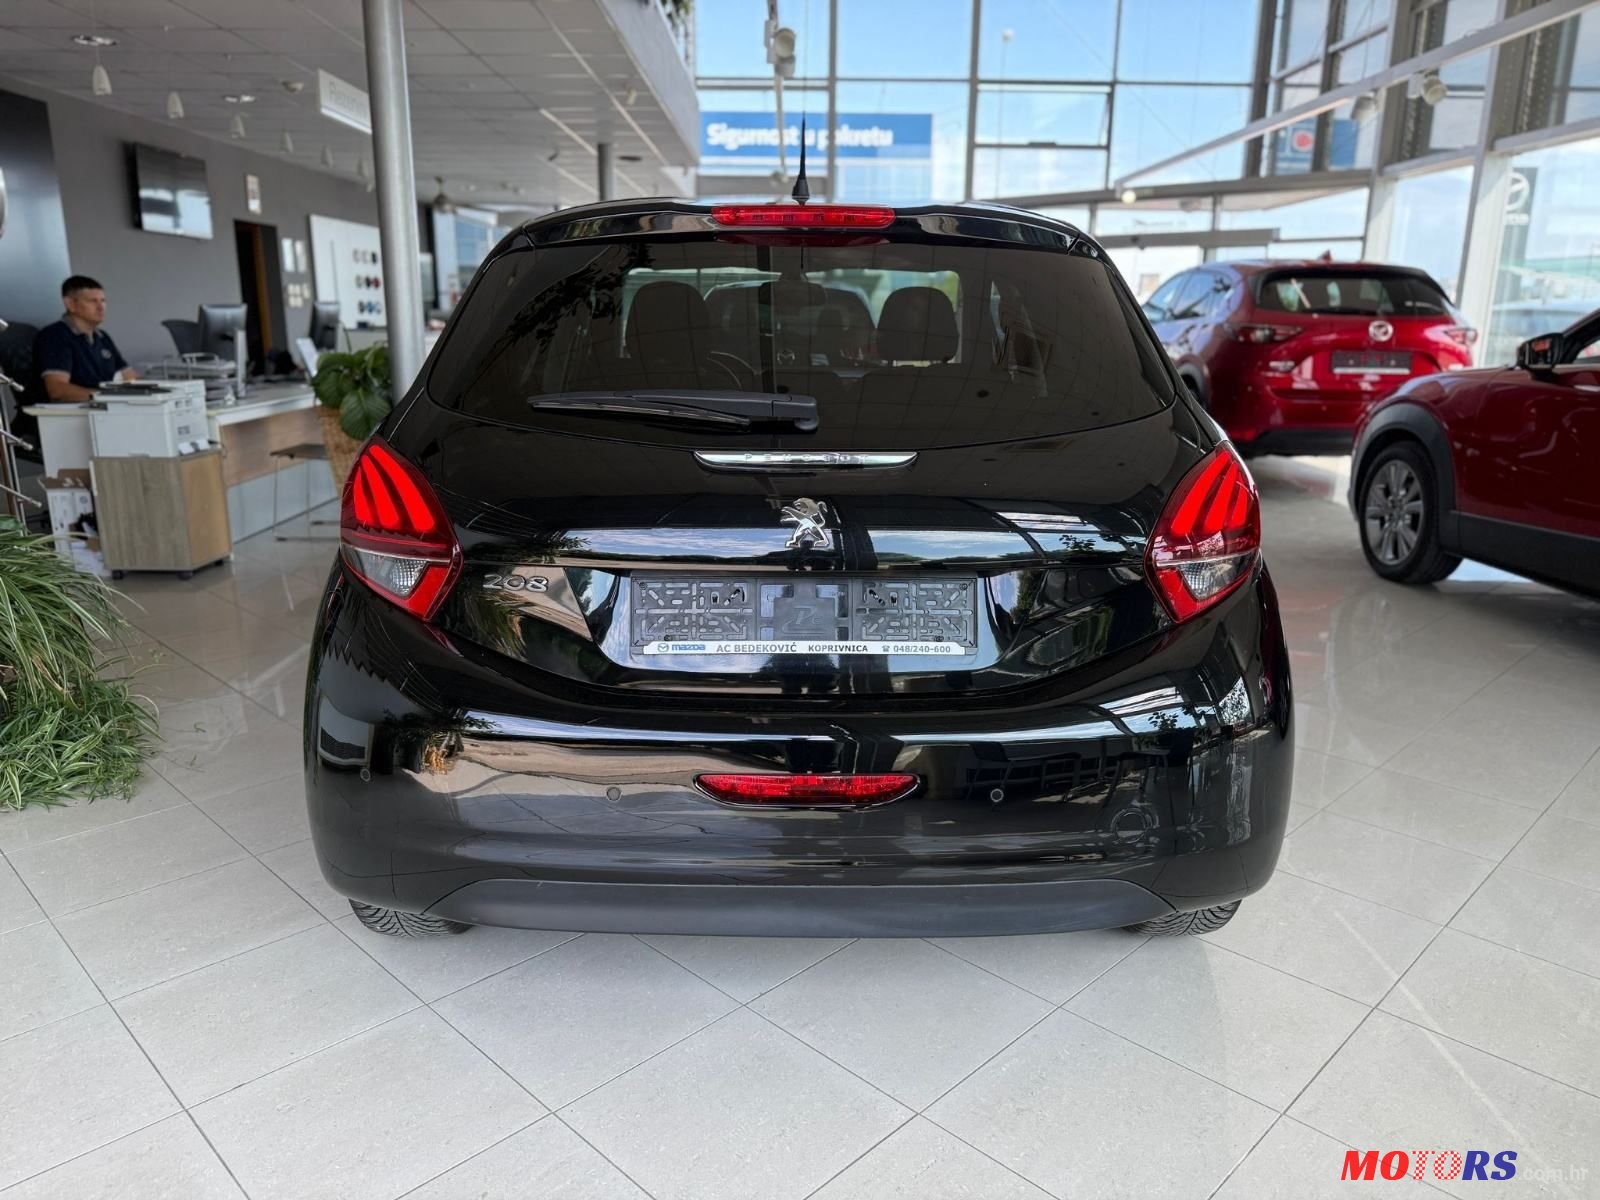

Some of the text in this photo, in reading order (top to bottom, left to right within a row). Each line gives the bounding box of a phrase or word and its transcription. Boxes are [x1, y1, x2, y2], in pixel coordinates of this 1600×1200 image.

[482, 573, 548, 592] 208
[716, 644, 731, 652] AC
[734, 641, 797, 653] BEDEKOVIĆ
[808, 644, 868, 653] KOPRIVNICA
